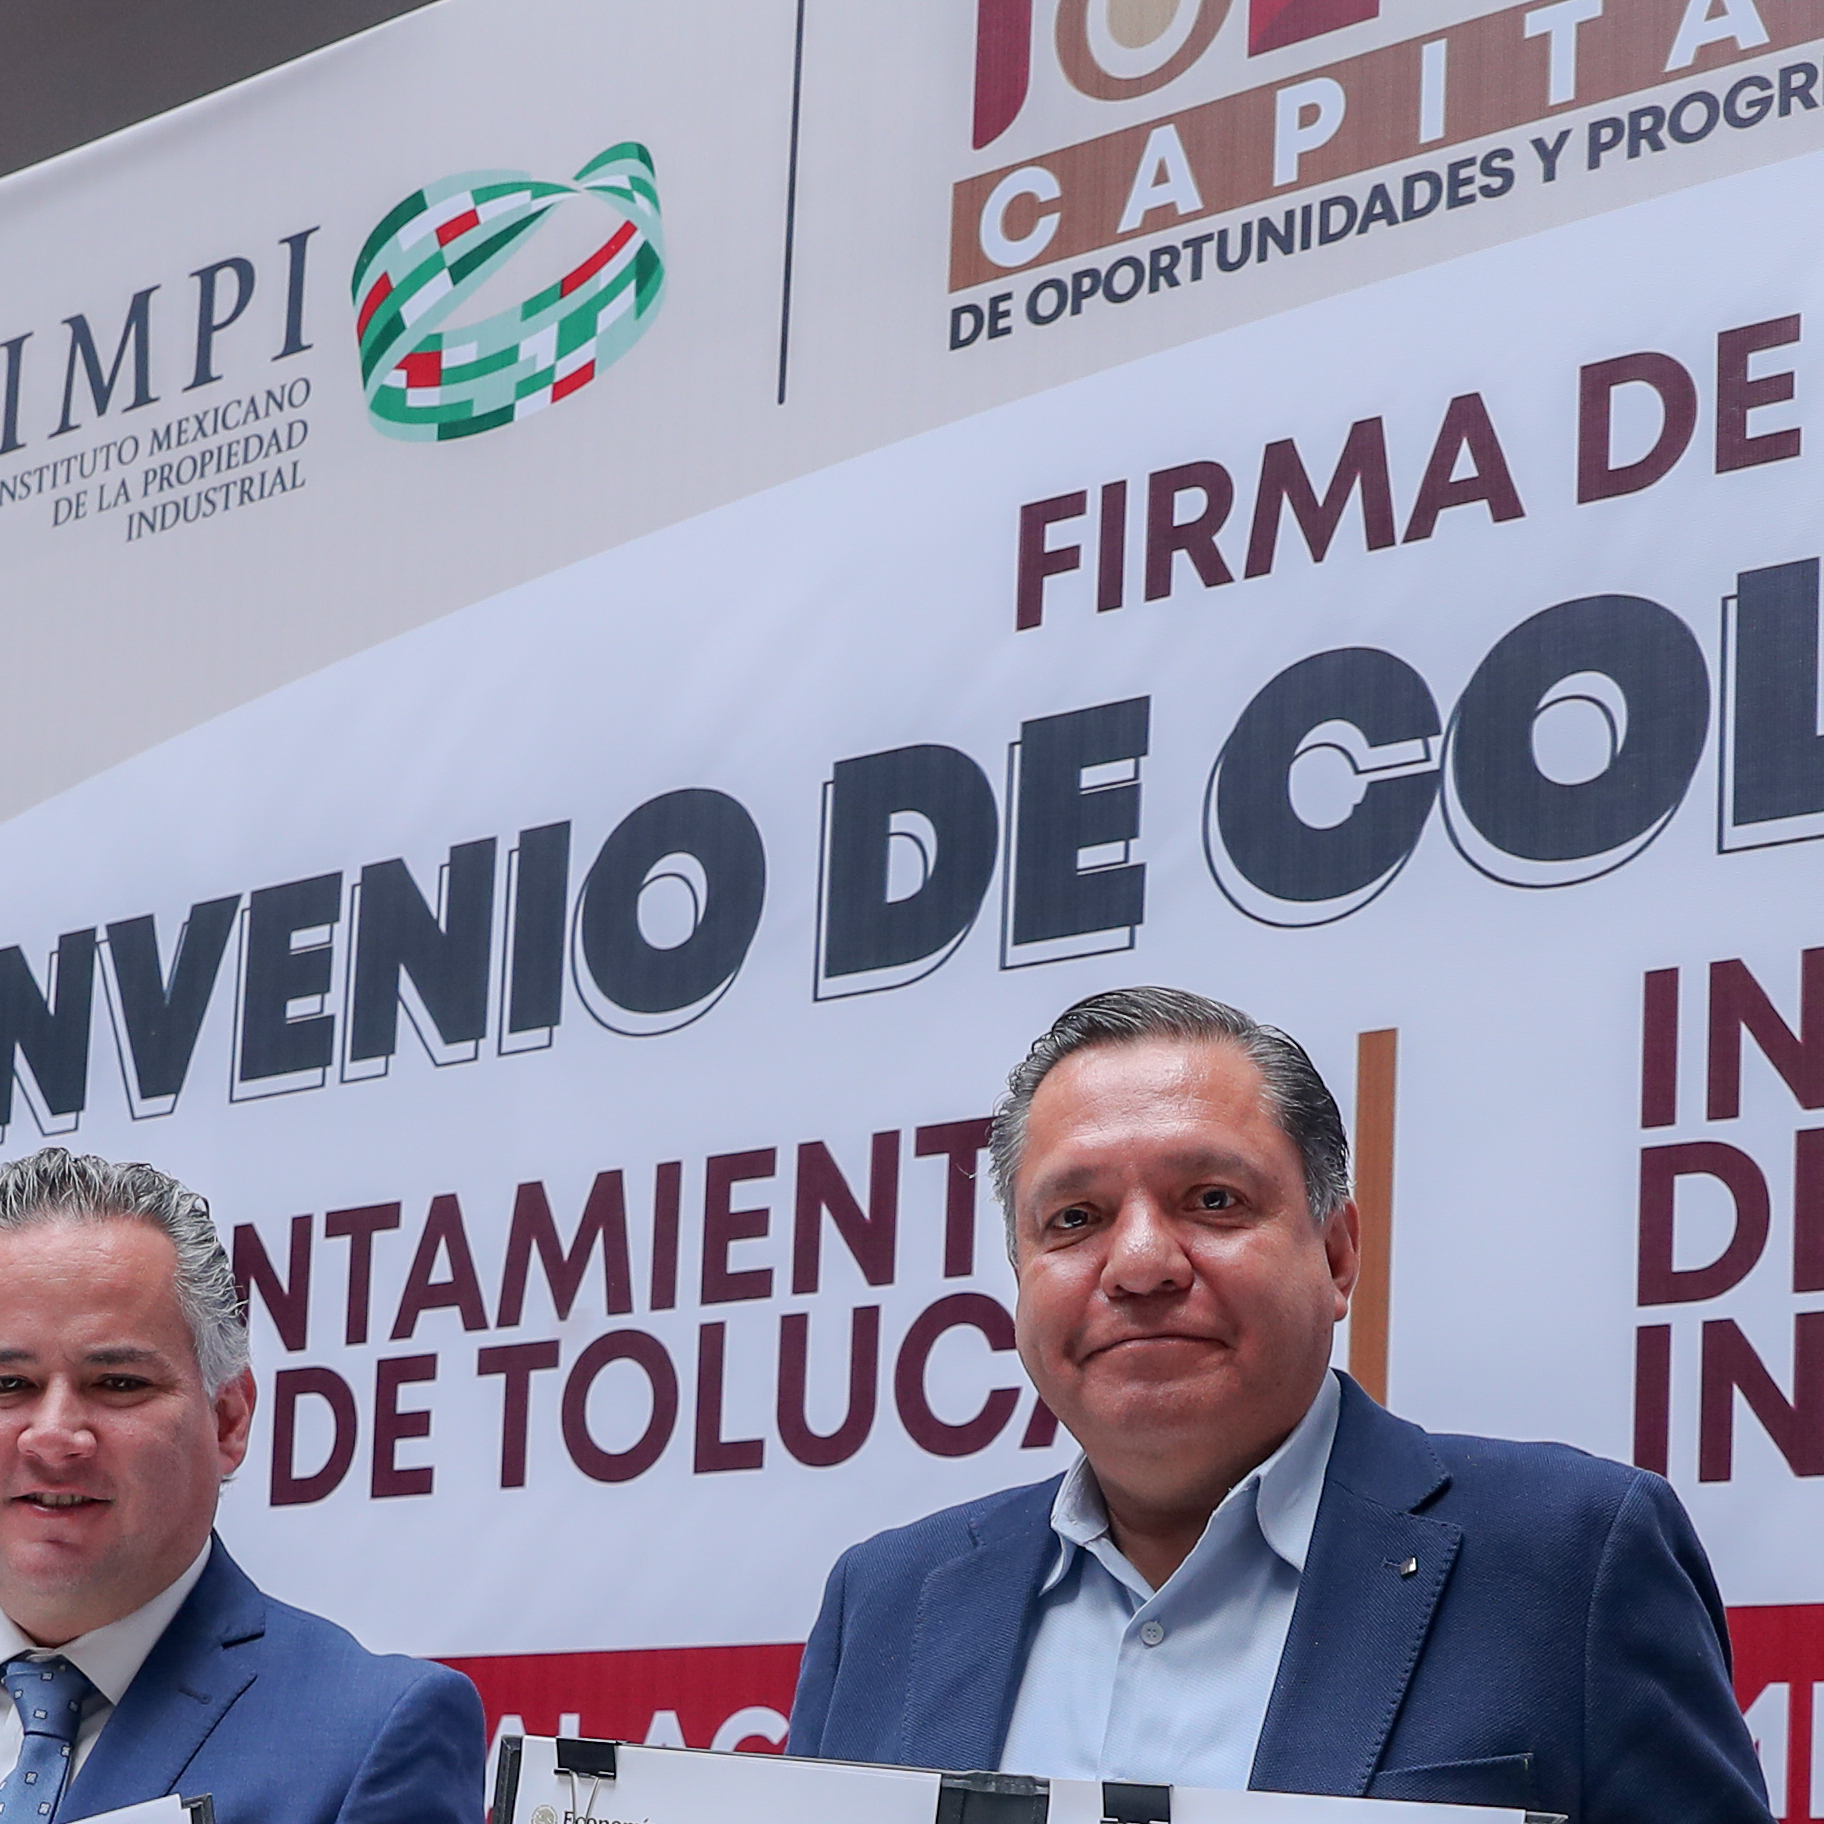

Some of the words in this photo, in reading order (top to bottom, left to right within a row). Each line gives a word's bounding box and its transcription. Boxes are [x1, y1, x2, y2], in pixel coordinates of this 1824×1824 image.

[949, 292, 1013, 351] DE
[1025, 147, 1514, 327] OPORTUNIDADES
[1530, 129, 1573, 184] Y
[51, 490, 88, 528] DE
[96, 478, 131, 513] LA
[141, 419, 310, 499] PROPIEDAD
[125, 459, 307, 543] INDUSTRIAL
[148, 377, 312, 456] MEXICANO
[1014, 391, 1525, 632] FIRMA
[1576, 313, 1802, 506] DE
[812, 698, 1150, 1001] DE
[231, 1116, 999, 1352] NTAMIENT
[269, 1353, 438, 1507] DE
